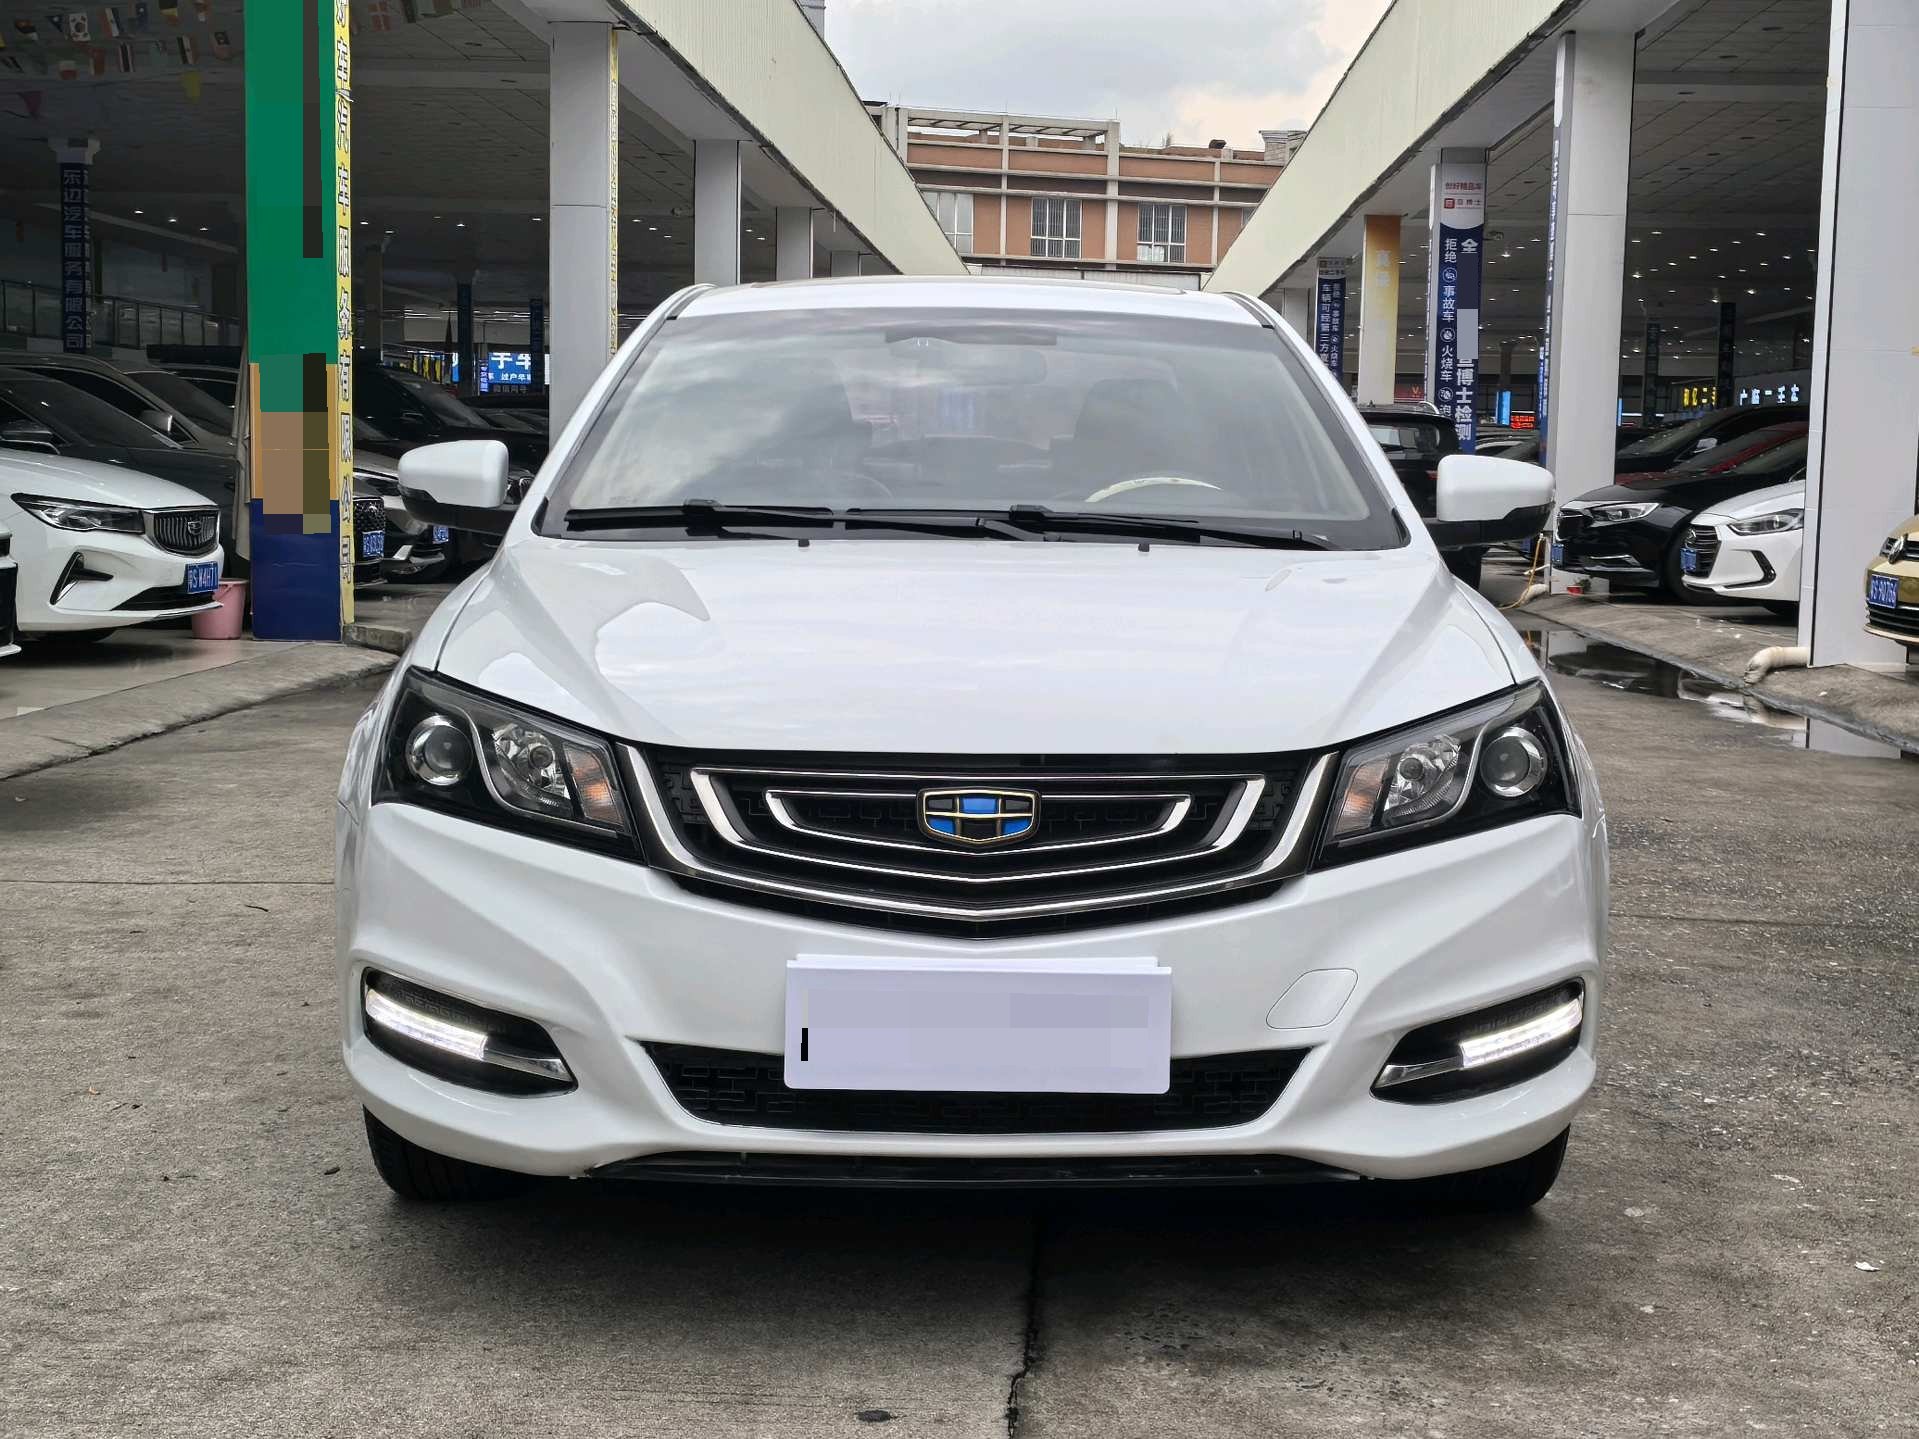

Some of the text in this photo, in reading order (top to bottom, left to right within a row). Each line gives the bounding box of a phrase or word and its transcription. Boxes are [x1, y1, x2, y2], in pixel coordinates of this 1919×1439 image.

[1444, 238, 1457, 263] 拒绝
[1460, 238, 1478, 254] 全
[1442, 285, 1456, 322] 事故车
[1440, 345, 1453, 383] 火烧车
